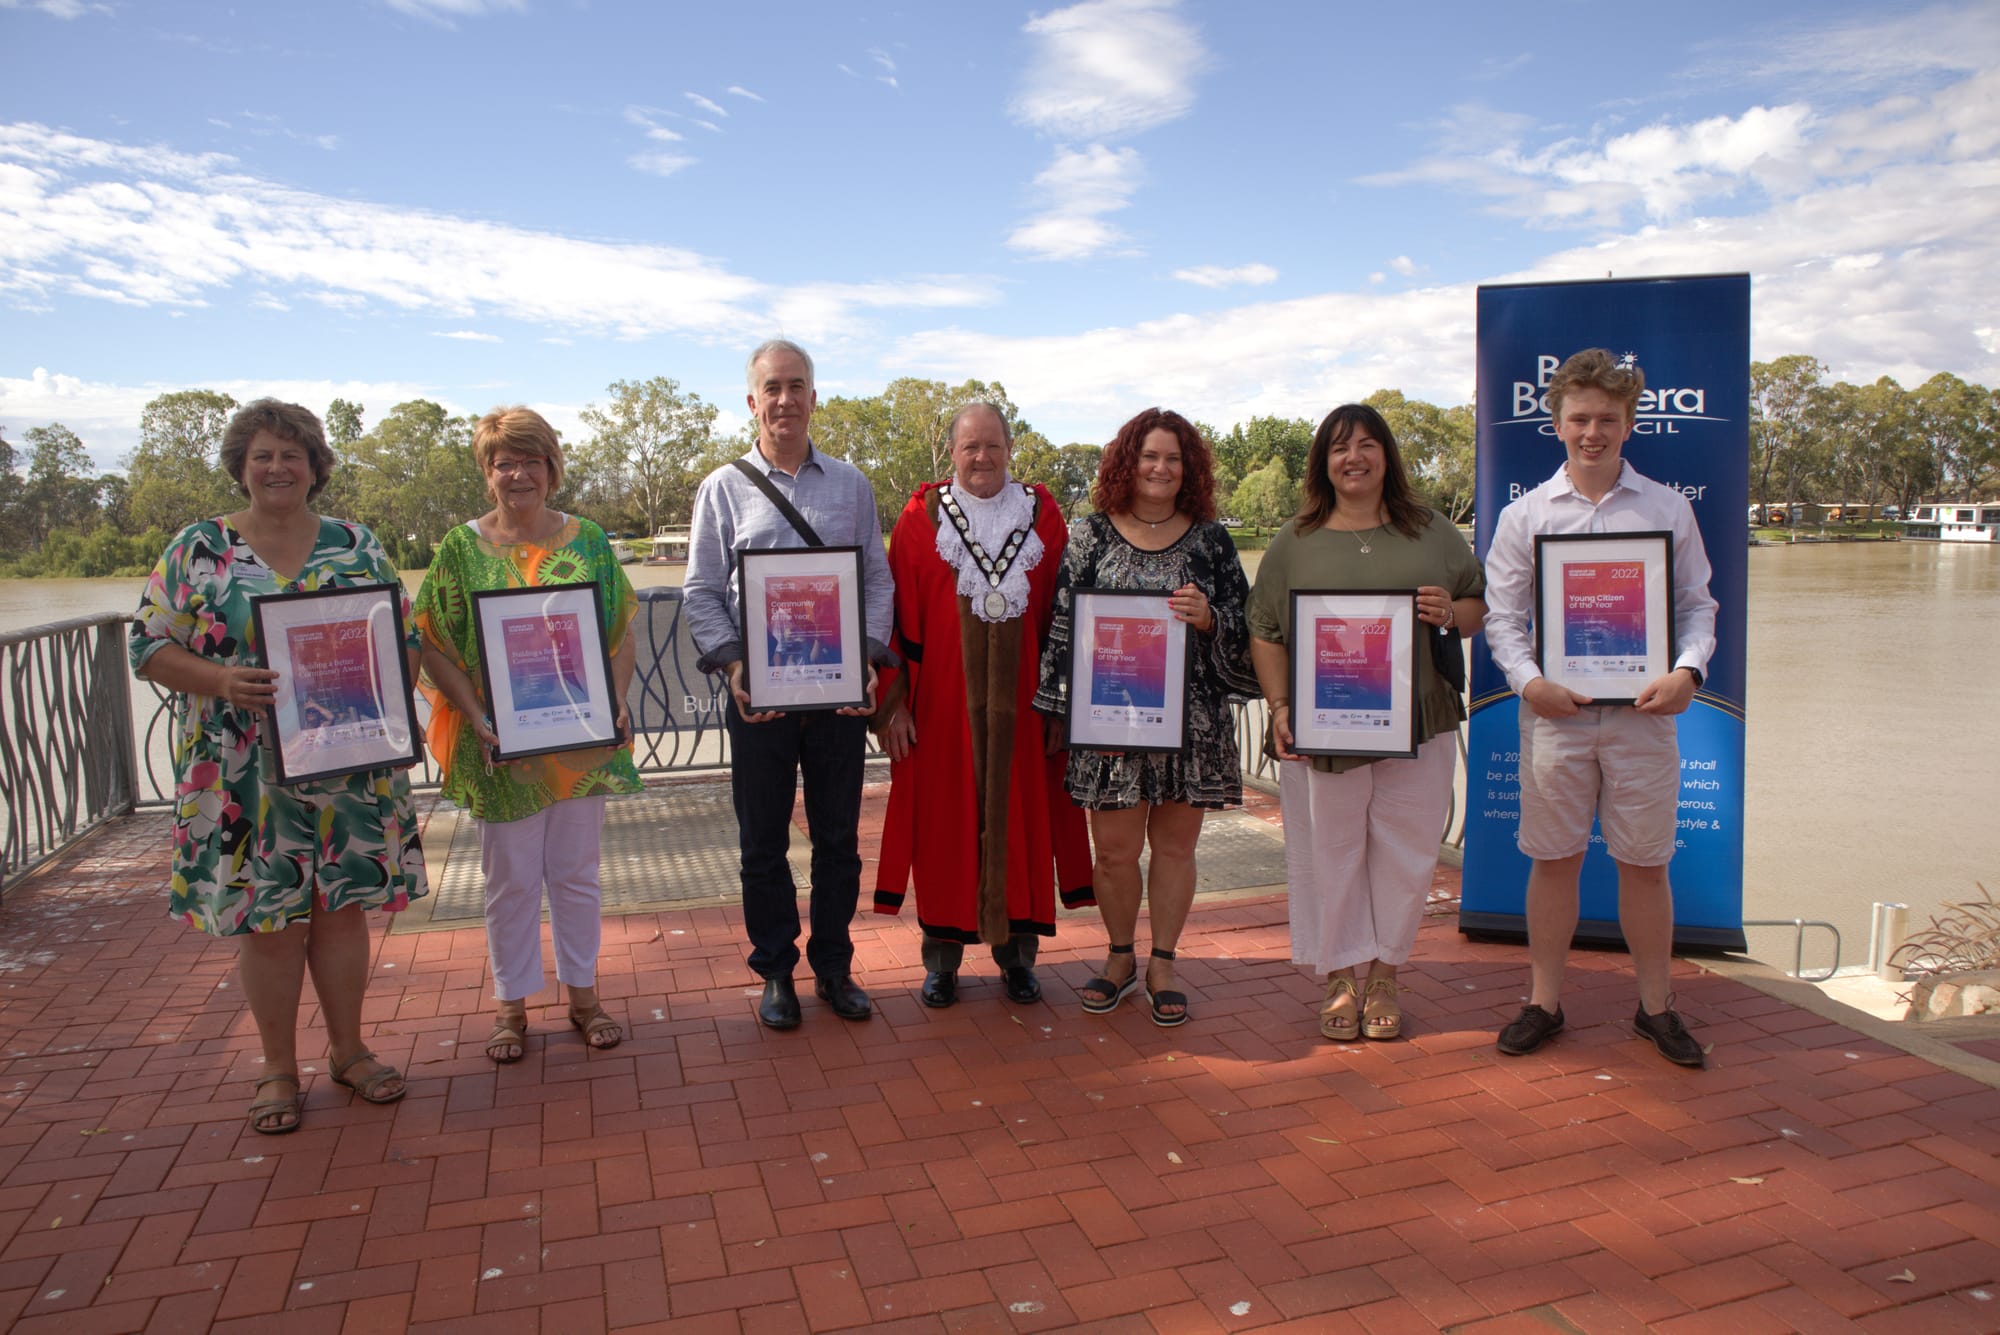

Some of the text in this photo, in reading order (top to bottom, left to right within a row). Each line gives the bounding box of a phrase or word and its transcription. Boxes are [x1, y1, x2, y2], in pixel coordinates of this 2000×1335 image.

[1537, 421, 1680, 436] CCIL
[1611, 568, 1639, 579] 2022
[1569, 594, 1625, 604] Young Citizen
[1594, 601, 1613, 609] Year
[340, 626, 368, 641] 2022
[1137, 624, 1163, 635] 2022
[1360, 624, 1387, 634] 2022
[1098, 647, 1123, 655] Citizen
[1491, 751, 1502, 761] In
[1689, 759, 1717, 771] shall
[1486, 769, 1502, 781] be
[1683, 778, 1720, 791] which
[1487, 789, 1496, 800] is
[1483, 808, 1520, 820] where
[1711, 819, 1721, 830] &
